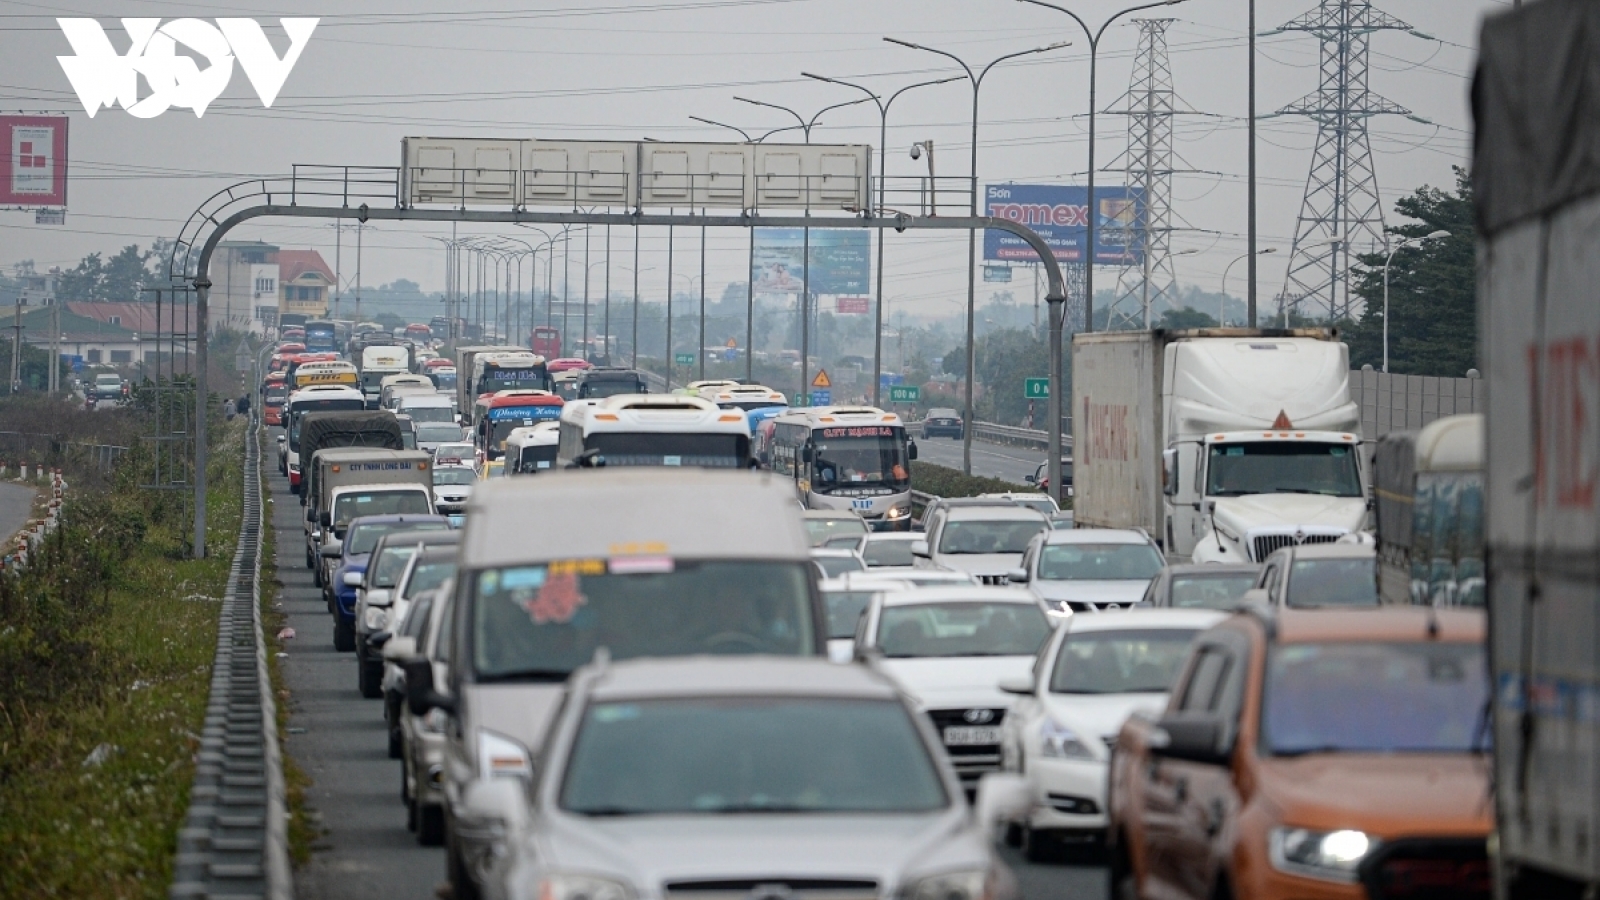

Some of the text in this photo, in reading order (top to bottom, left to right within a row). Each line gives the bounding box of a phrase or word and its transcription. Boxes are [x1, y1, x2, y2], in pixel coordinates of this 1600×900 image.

[988, 186, 1011, 199] Sơn
[1034, 383, 1040, 394] 0
[893, 389, 916, 399] 100 M
[363, 463, 380, 471] TNHH
[852, 500, 873, 510] VIP
